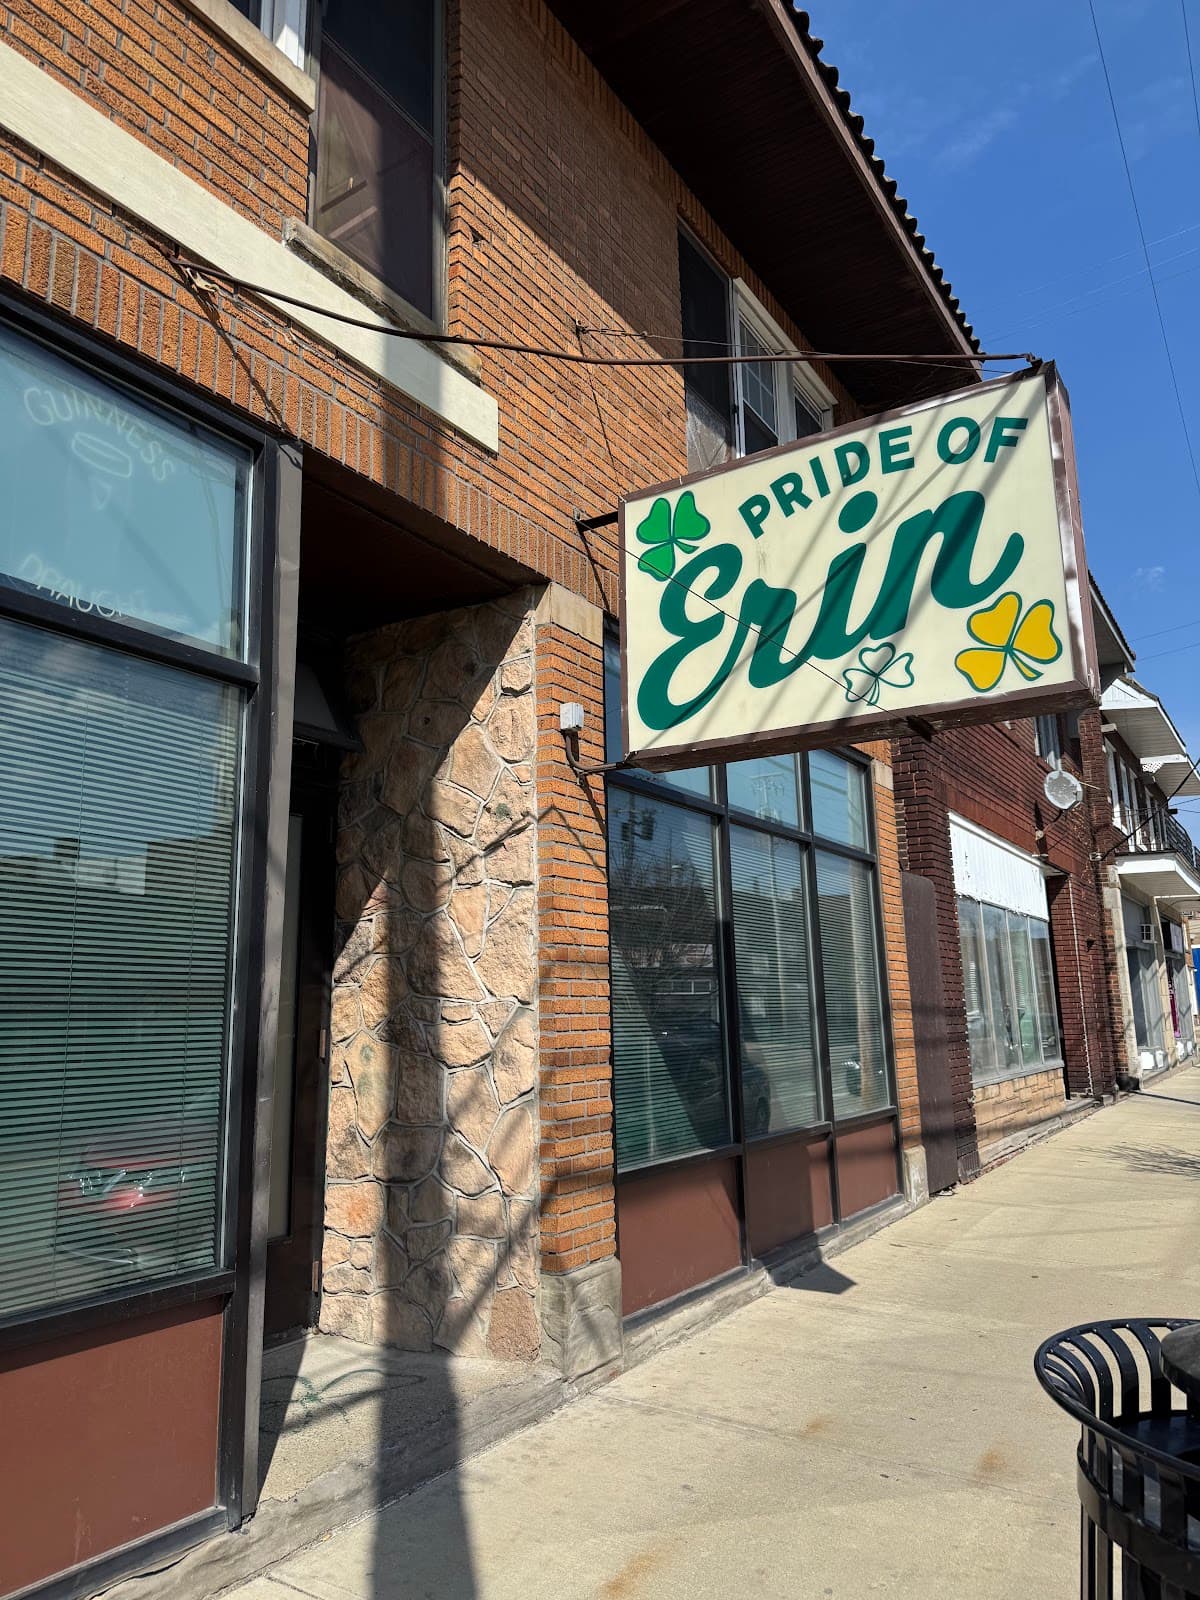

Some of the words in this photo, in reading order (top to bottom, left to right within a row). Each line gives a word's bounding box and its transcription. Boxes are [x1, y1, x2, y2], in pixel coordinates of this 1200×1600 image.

[24, 386, 175, 481] GUINNESS
[738, 425, 915, 539] PRIDE
[936, 416, 1028, 465] OF
[637, 490, 1025, 730] Erin
